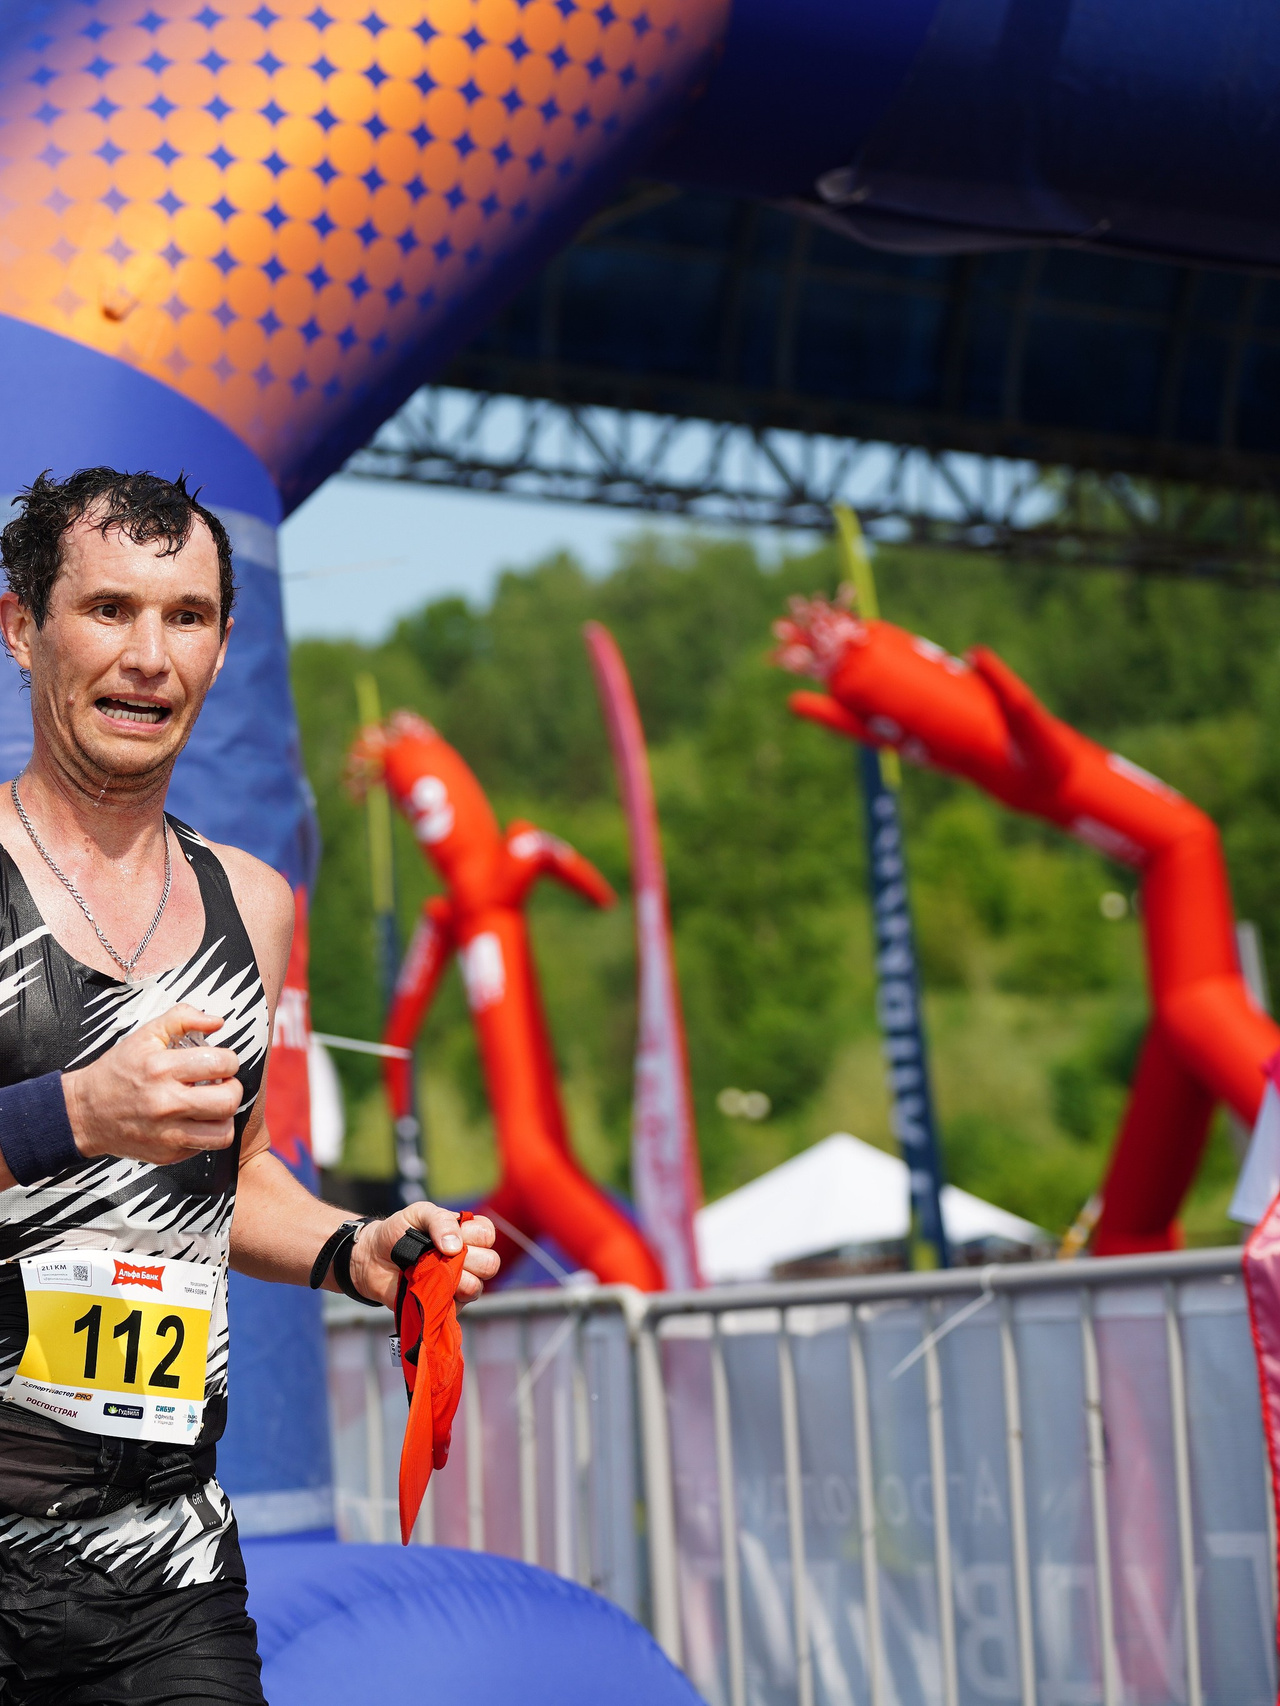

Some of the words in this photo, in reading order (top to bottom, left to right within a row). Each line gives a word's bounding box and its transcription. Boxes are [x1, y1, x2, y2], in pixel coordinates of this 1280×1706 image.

[118, 1268, 140, 1279] Альфа
[141, 1271, 159, 1281] Банк
[73, 1304, 186, 1389] 112
[74, 1393, 92, 1401] PRO
[26, 1397, 79, 1418] РОСГОССТРАХ
[155, 1405, 176, 1413] СИБУР
